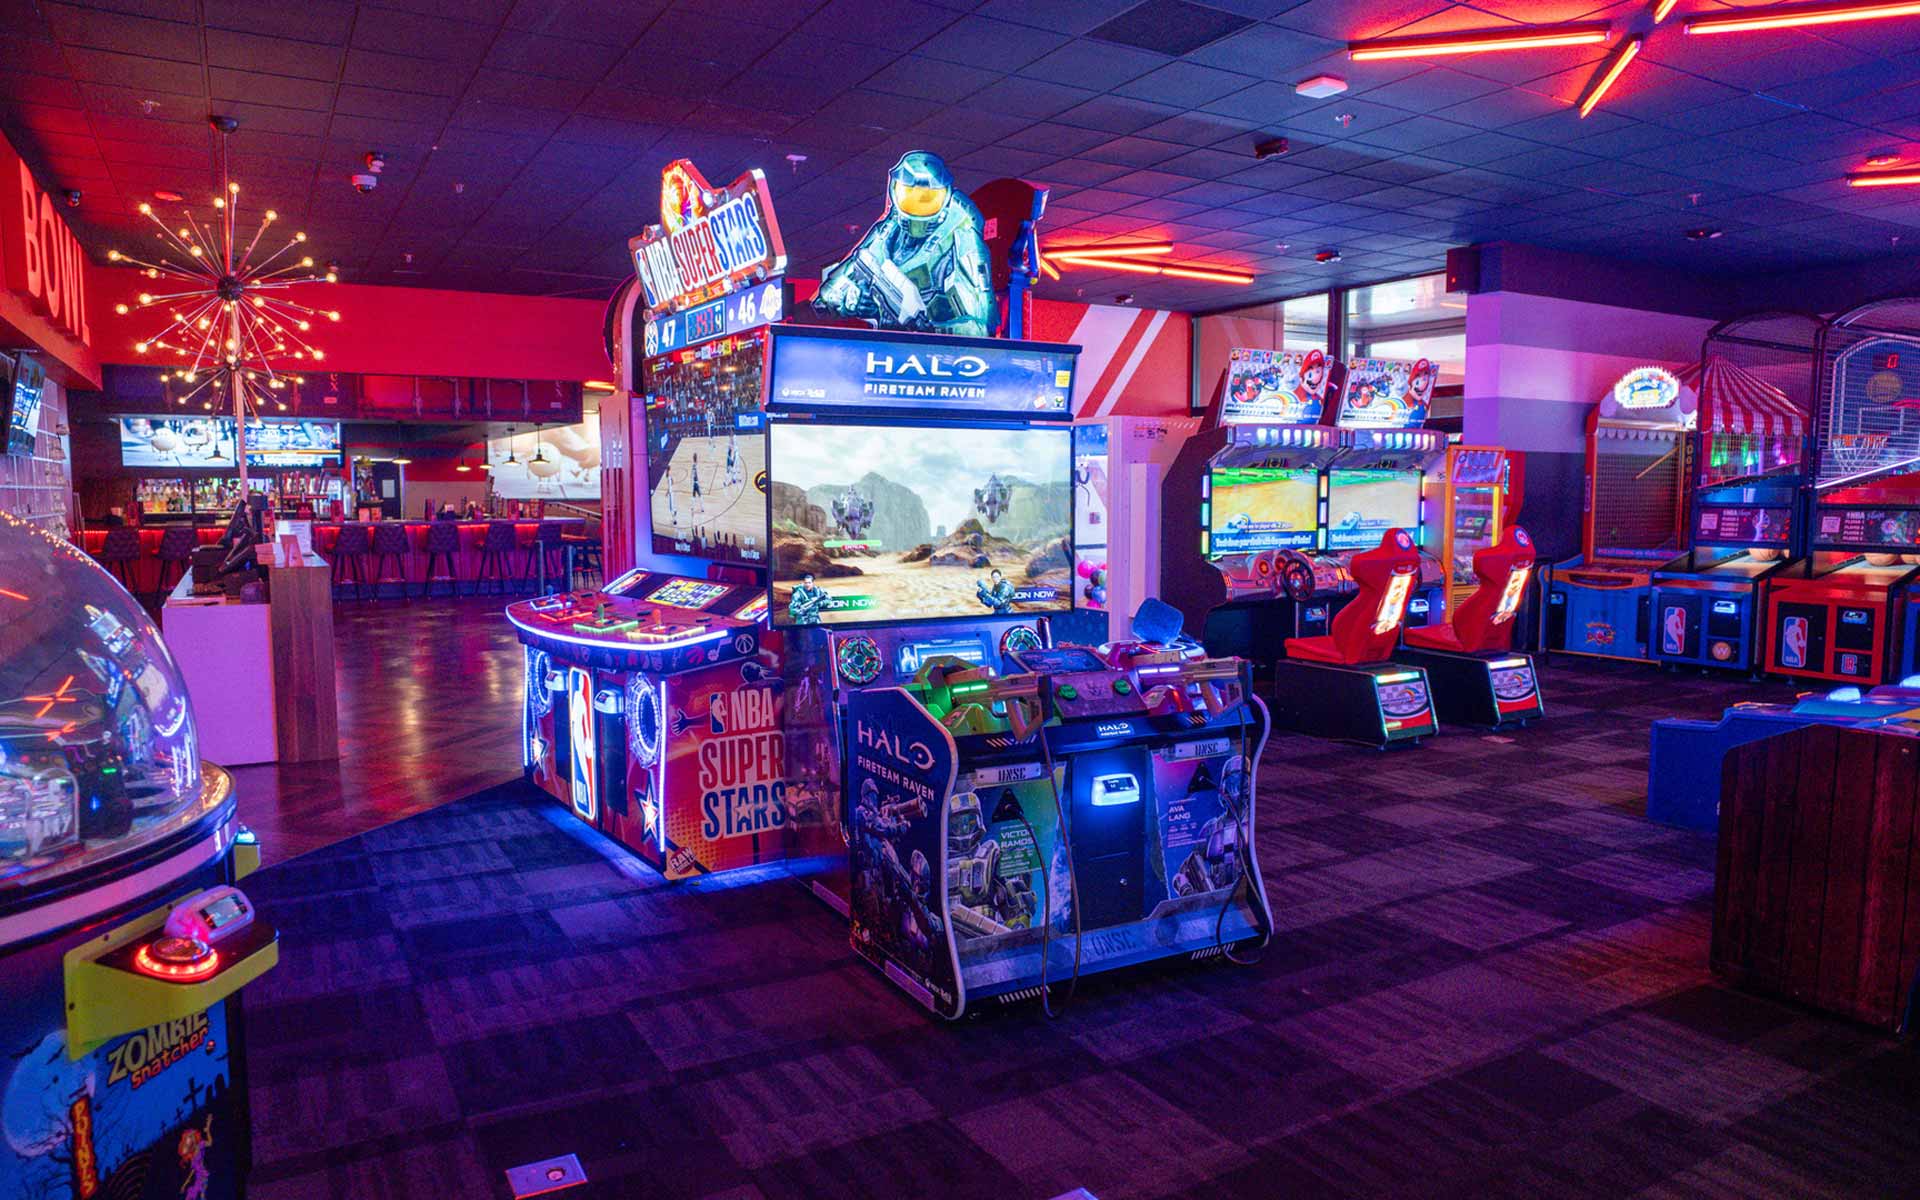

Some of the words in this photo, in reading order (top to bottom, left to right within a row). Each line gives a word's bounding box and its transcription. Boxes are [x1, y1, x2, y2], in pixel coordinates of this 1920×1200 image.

[19, 158, 90, 347] BOWL
[646, 237, 684, 302] NBA
[673, 219, 723, 288] SUPER
[709, 195, 766, 272] STARS
[738, 293, 757, 325] 46
[661, 319, 677, 347] 47
[866, 352, 990, 377] HALO
[864, 383, 935, 397] FIRETEAM
[940, 385, 986, 398] RAVEN
[852, 598, 877, 608] NOW
[1033, 590, 1056, 599] NOW
[730, 687, 775, 731] NBA
[1098, 722, 1129, 732] HALO
[701, 733, 785, 789] SUPER
[857, 719, 936, 770] HALO
[857, 755, 900, 785] FIRETEAM
[902, 776, 935, 801] RAVEN
[703, 780, 786, 839] STARS
[131, 1026, 209, 1090] snatcher
